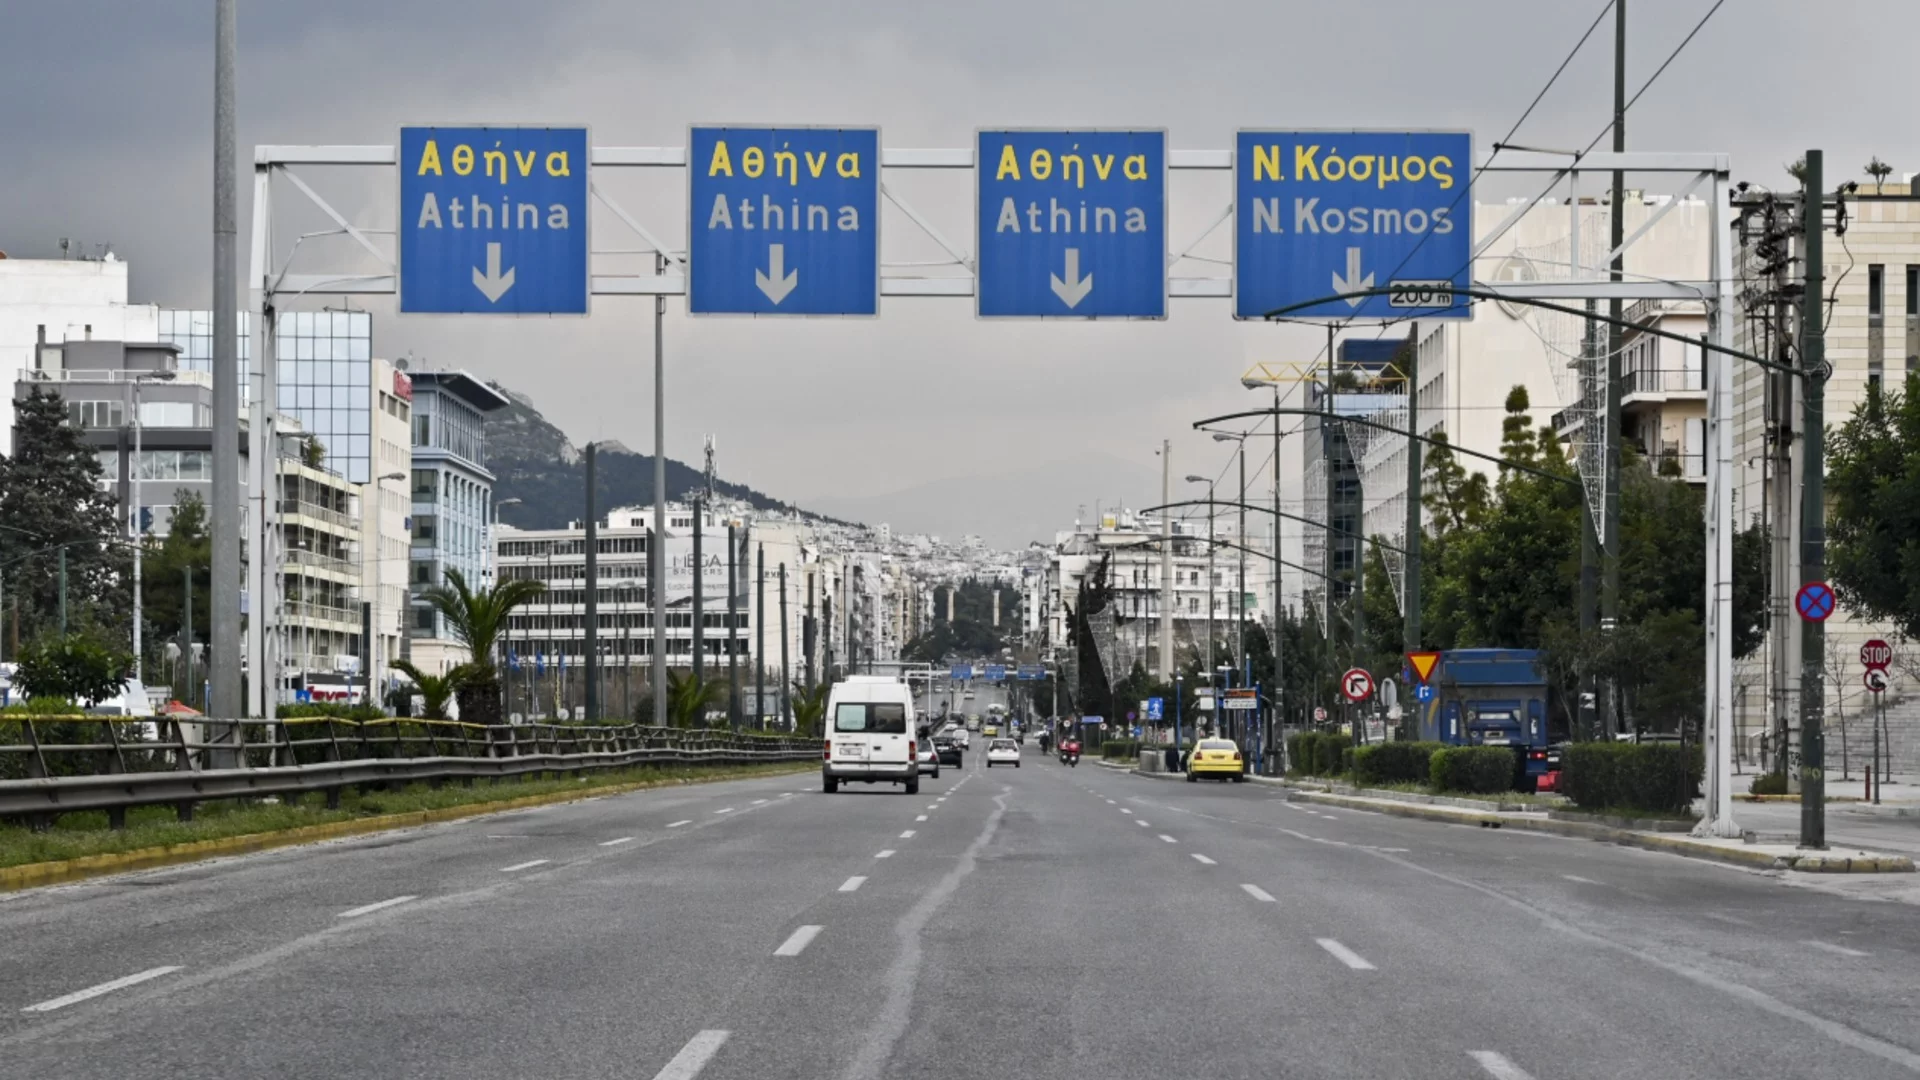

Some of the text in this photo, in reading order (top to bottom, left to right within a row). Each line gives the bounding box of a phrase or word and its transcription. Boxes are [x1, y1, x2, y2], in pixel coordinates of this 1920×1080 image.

[418, 140, 570, 185] Αθήνα
[708, 141, 860, 186] Αθήνα
[996, 144, 1147, 189] Αθήνα
[1253, 145, 1454, 190] Ν. Κόσμος
[418, 192, 569, 229] Athina
[708, 193, 859, 231] Athina
[996, 197, 1147, 233] Athina
[1253, 198, 1454, 234] N. Kosmos
[1391, 283, 1433, 304] 200
[1862, 646, 1891, 664] STOP
